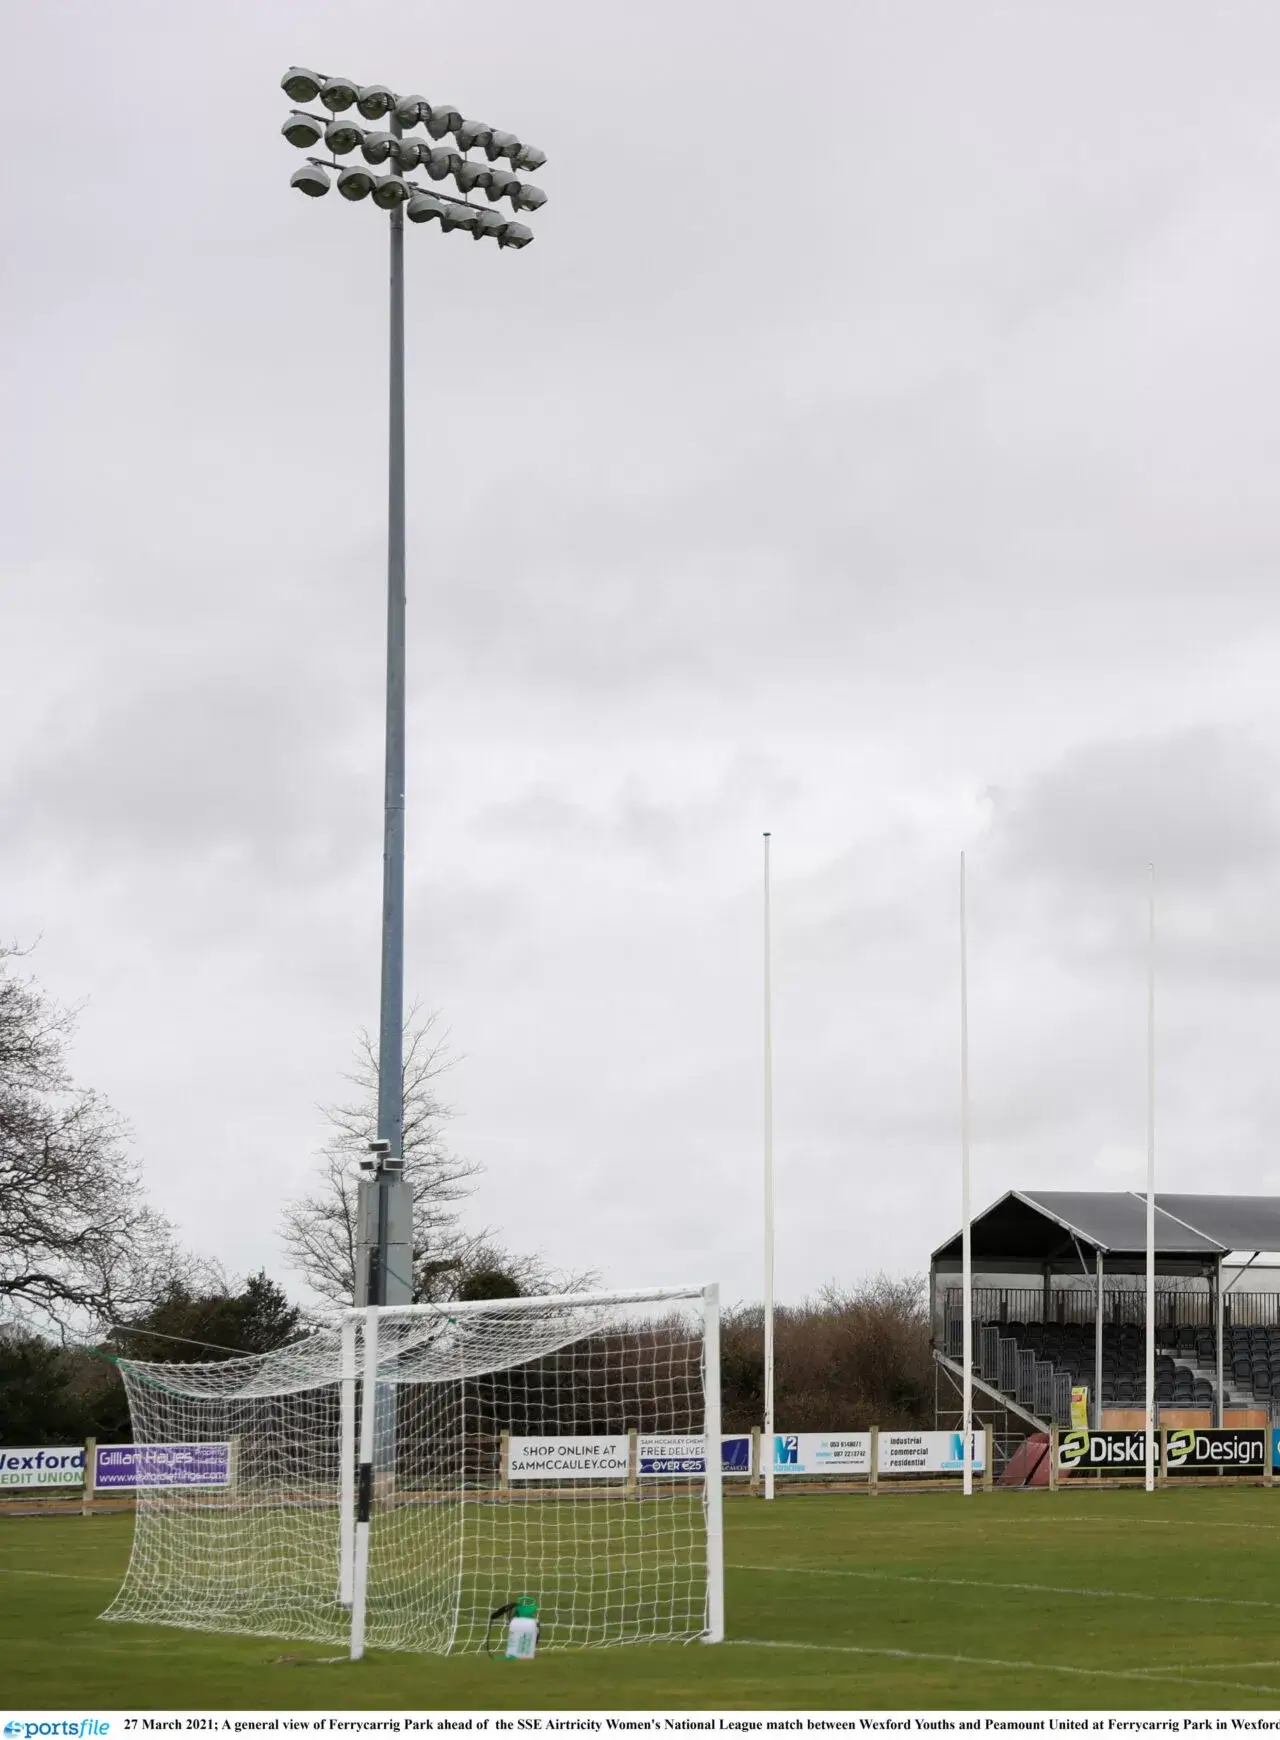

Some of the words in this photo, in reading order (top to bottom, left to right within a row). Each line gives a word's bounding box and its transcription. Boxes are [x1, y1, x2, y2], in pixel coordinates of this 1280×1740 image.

[890, 1437, 922, 1445] industrial
[523, 1446, 555, 1456] SHOP
[558, 1446, 600, 1456] ONLINE
[603, 1445, 617, 1455] AT
[641, 1446, 667, 1456] FREE
[669, 1446, 705, 1456] DELIVER
[890, 1447, 929, 1455] commercial
[1090, 1434, 1160, 1462] Diskin
[1195, 1437, 1263, 1463] Design
[512, 1459, 627, 1471] SAMMCCAULEY.COM
[652, 1461, 680, 1470] OVER
[682, 1461, 702, 1470] €25
[890, 1459, 926, 1467] residential
[0, 1473, 33, 1484] EDIT
[38, 1471, 85, 1483] UNION
